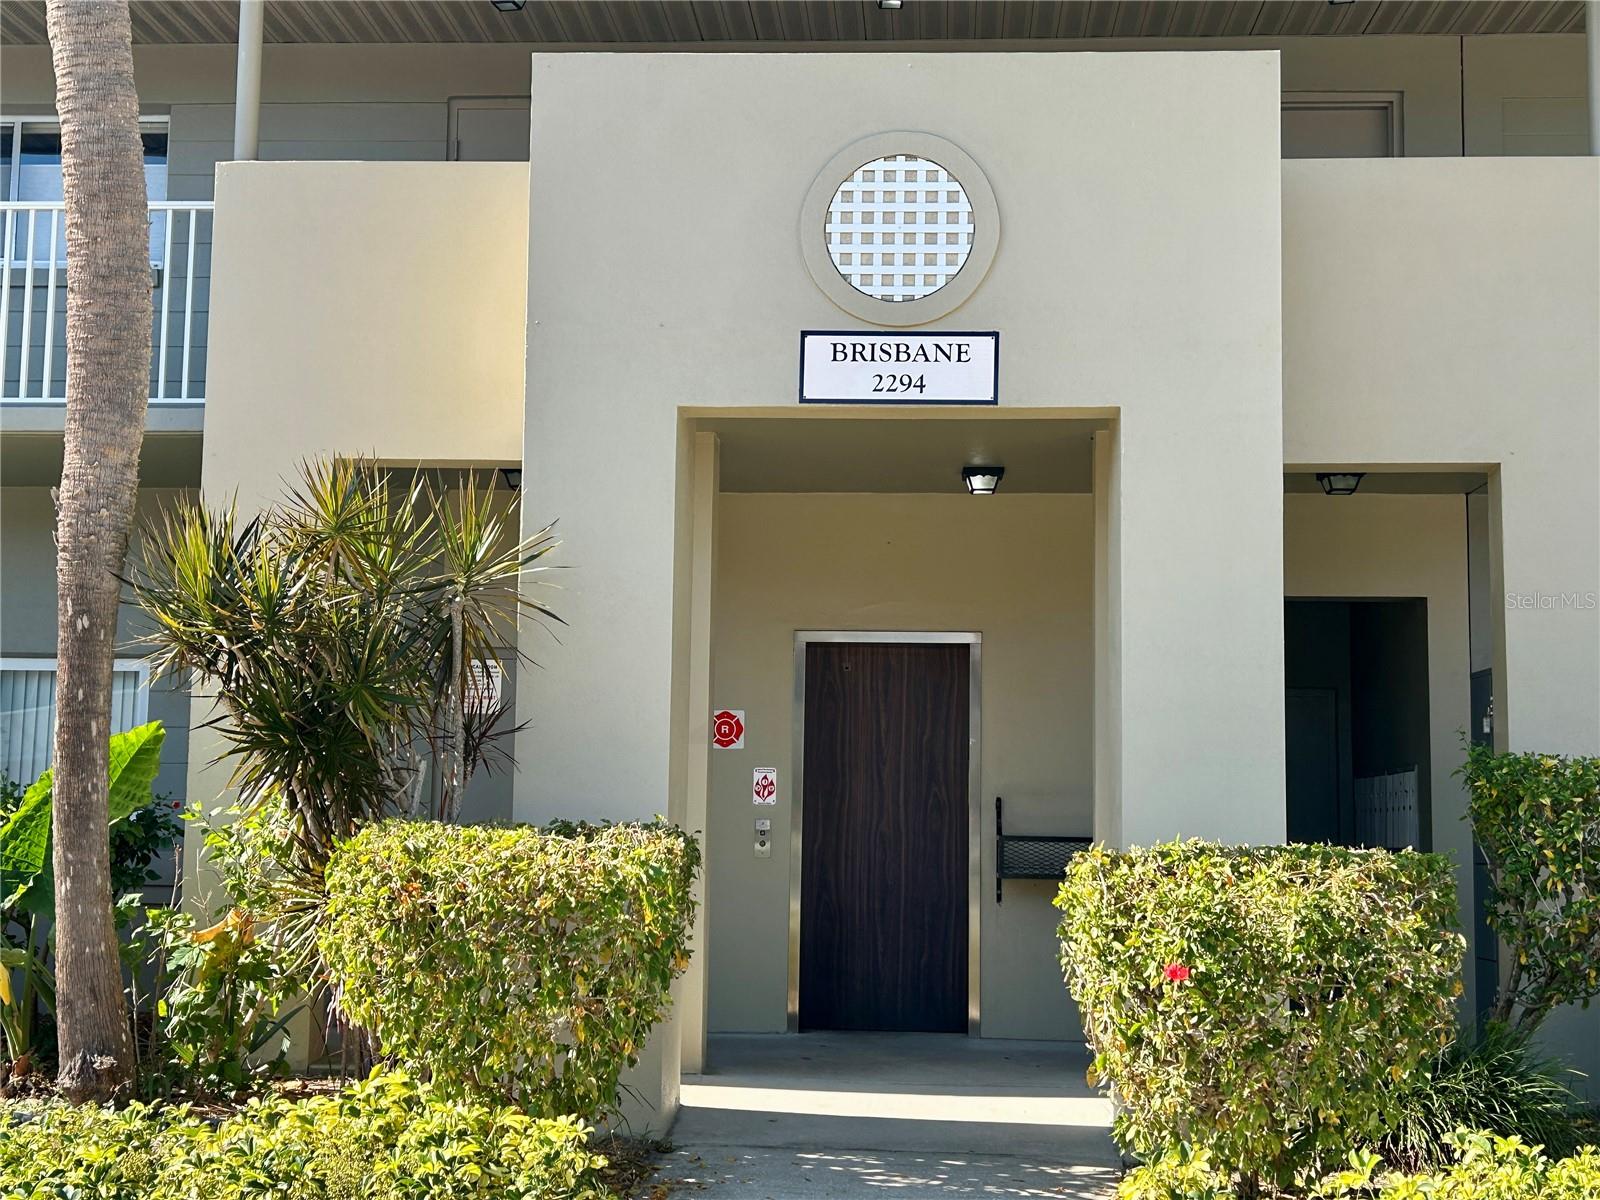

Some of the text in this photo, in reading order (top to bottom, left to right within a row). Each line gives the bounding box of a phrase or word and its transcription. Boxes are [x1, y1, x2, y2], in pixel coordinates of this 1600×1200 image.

[830, 342, 971, 363] BRISBANE
[872, 373, 926, 394] 2294
[721, 725, 729, 734] R
